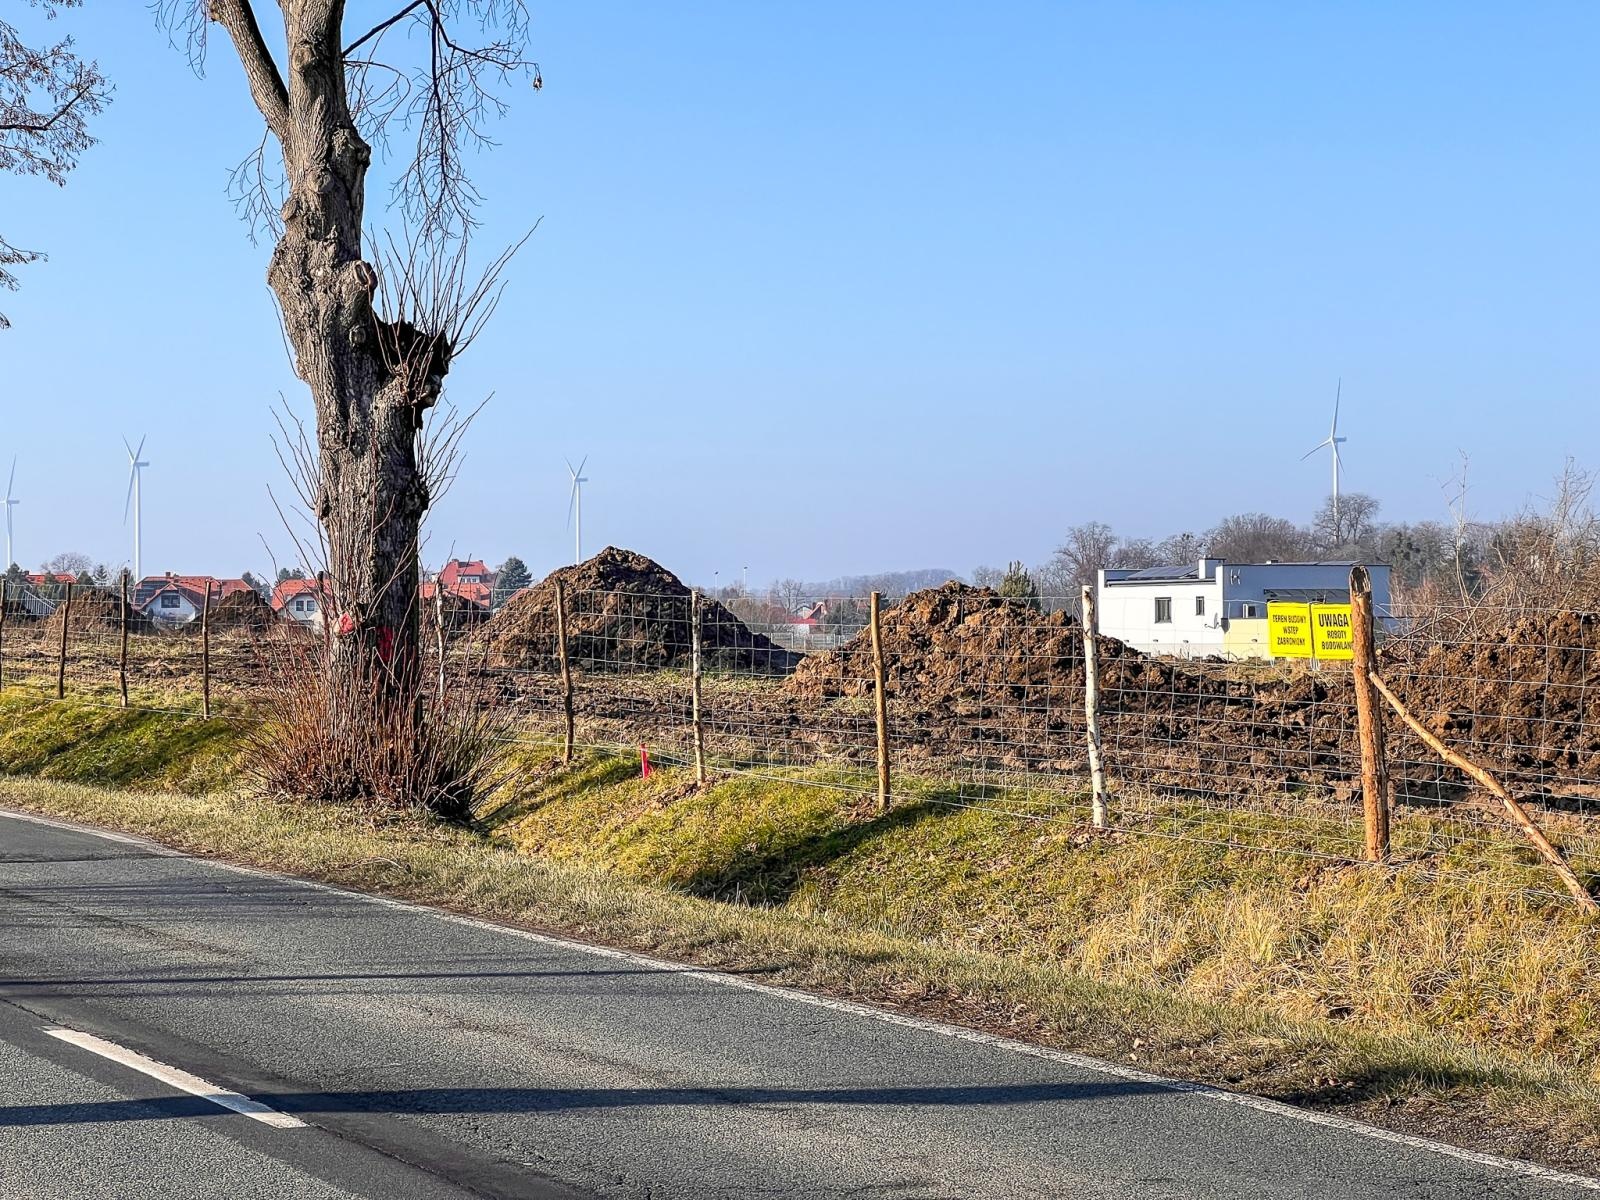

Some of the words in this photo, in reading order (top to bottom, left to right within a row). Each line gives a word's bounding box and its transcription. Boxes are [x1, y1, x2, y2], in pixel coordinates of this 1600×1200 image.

[1318, 613, 1349, 627] UWAGA
[1327, 630, 1347, 639] ROBOTY
[1322, 641, 1353, 650] BUDOWLAN
